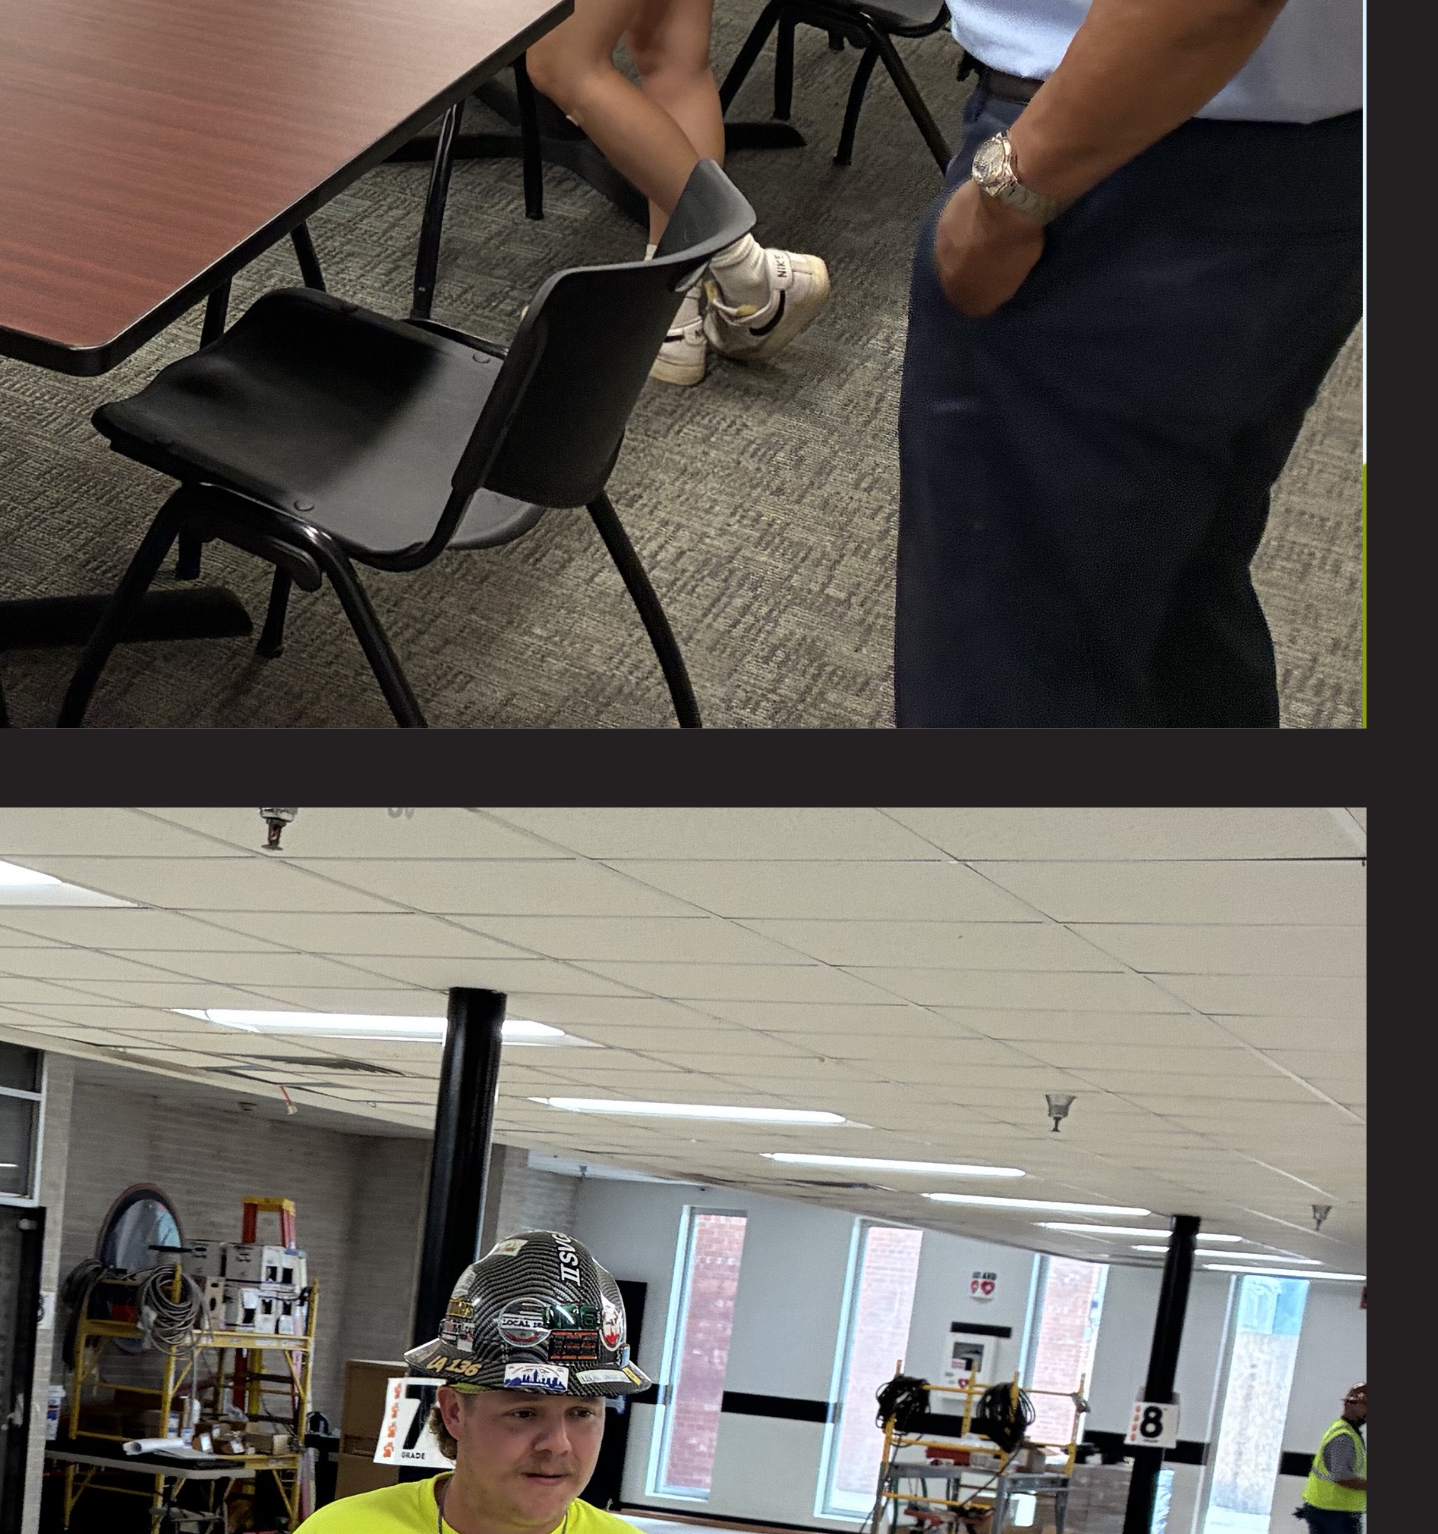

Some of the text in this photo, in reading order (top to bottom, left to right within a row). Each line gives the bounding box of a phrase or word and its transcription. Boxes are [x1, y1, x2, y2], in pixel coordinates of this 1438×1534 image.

[446, 1358, 482, 1376] 136
[1140, 1406, 1163, 1438] 8
[401, 1451, 426, 1460] GRADE
